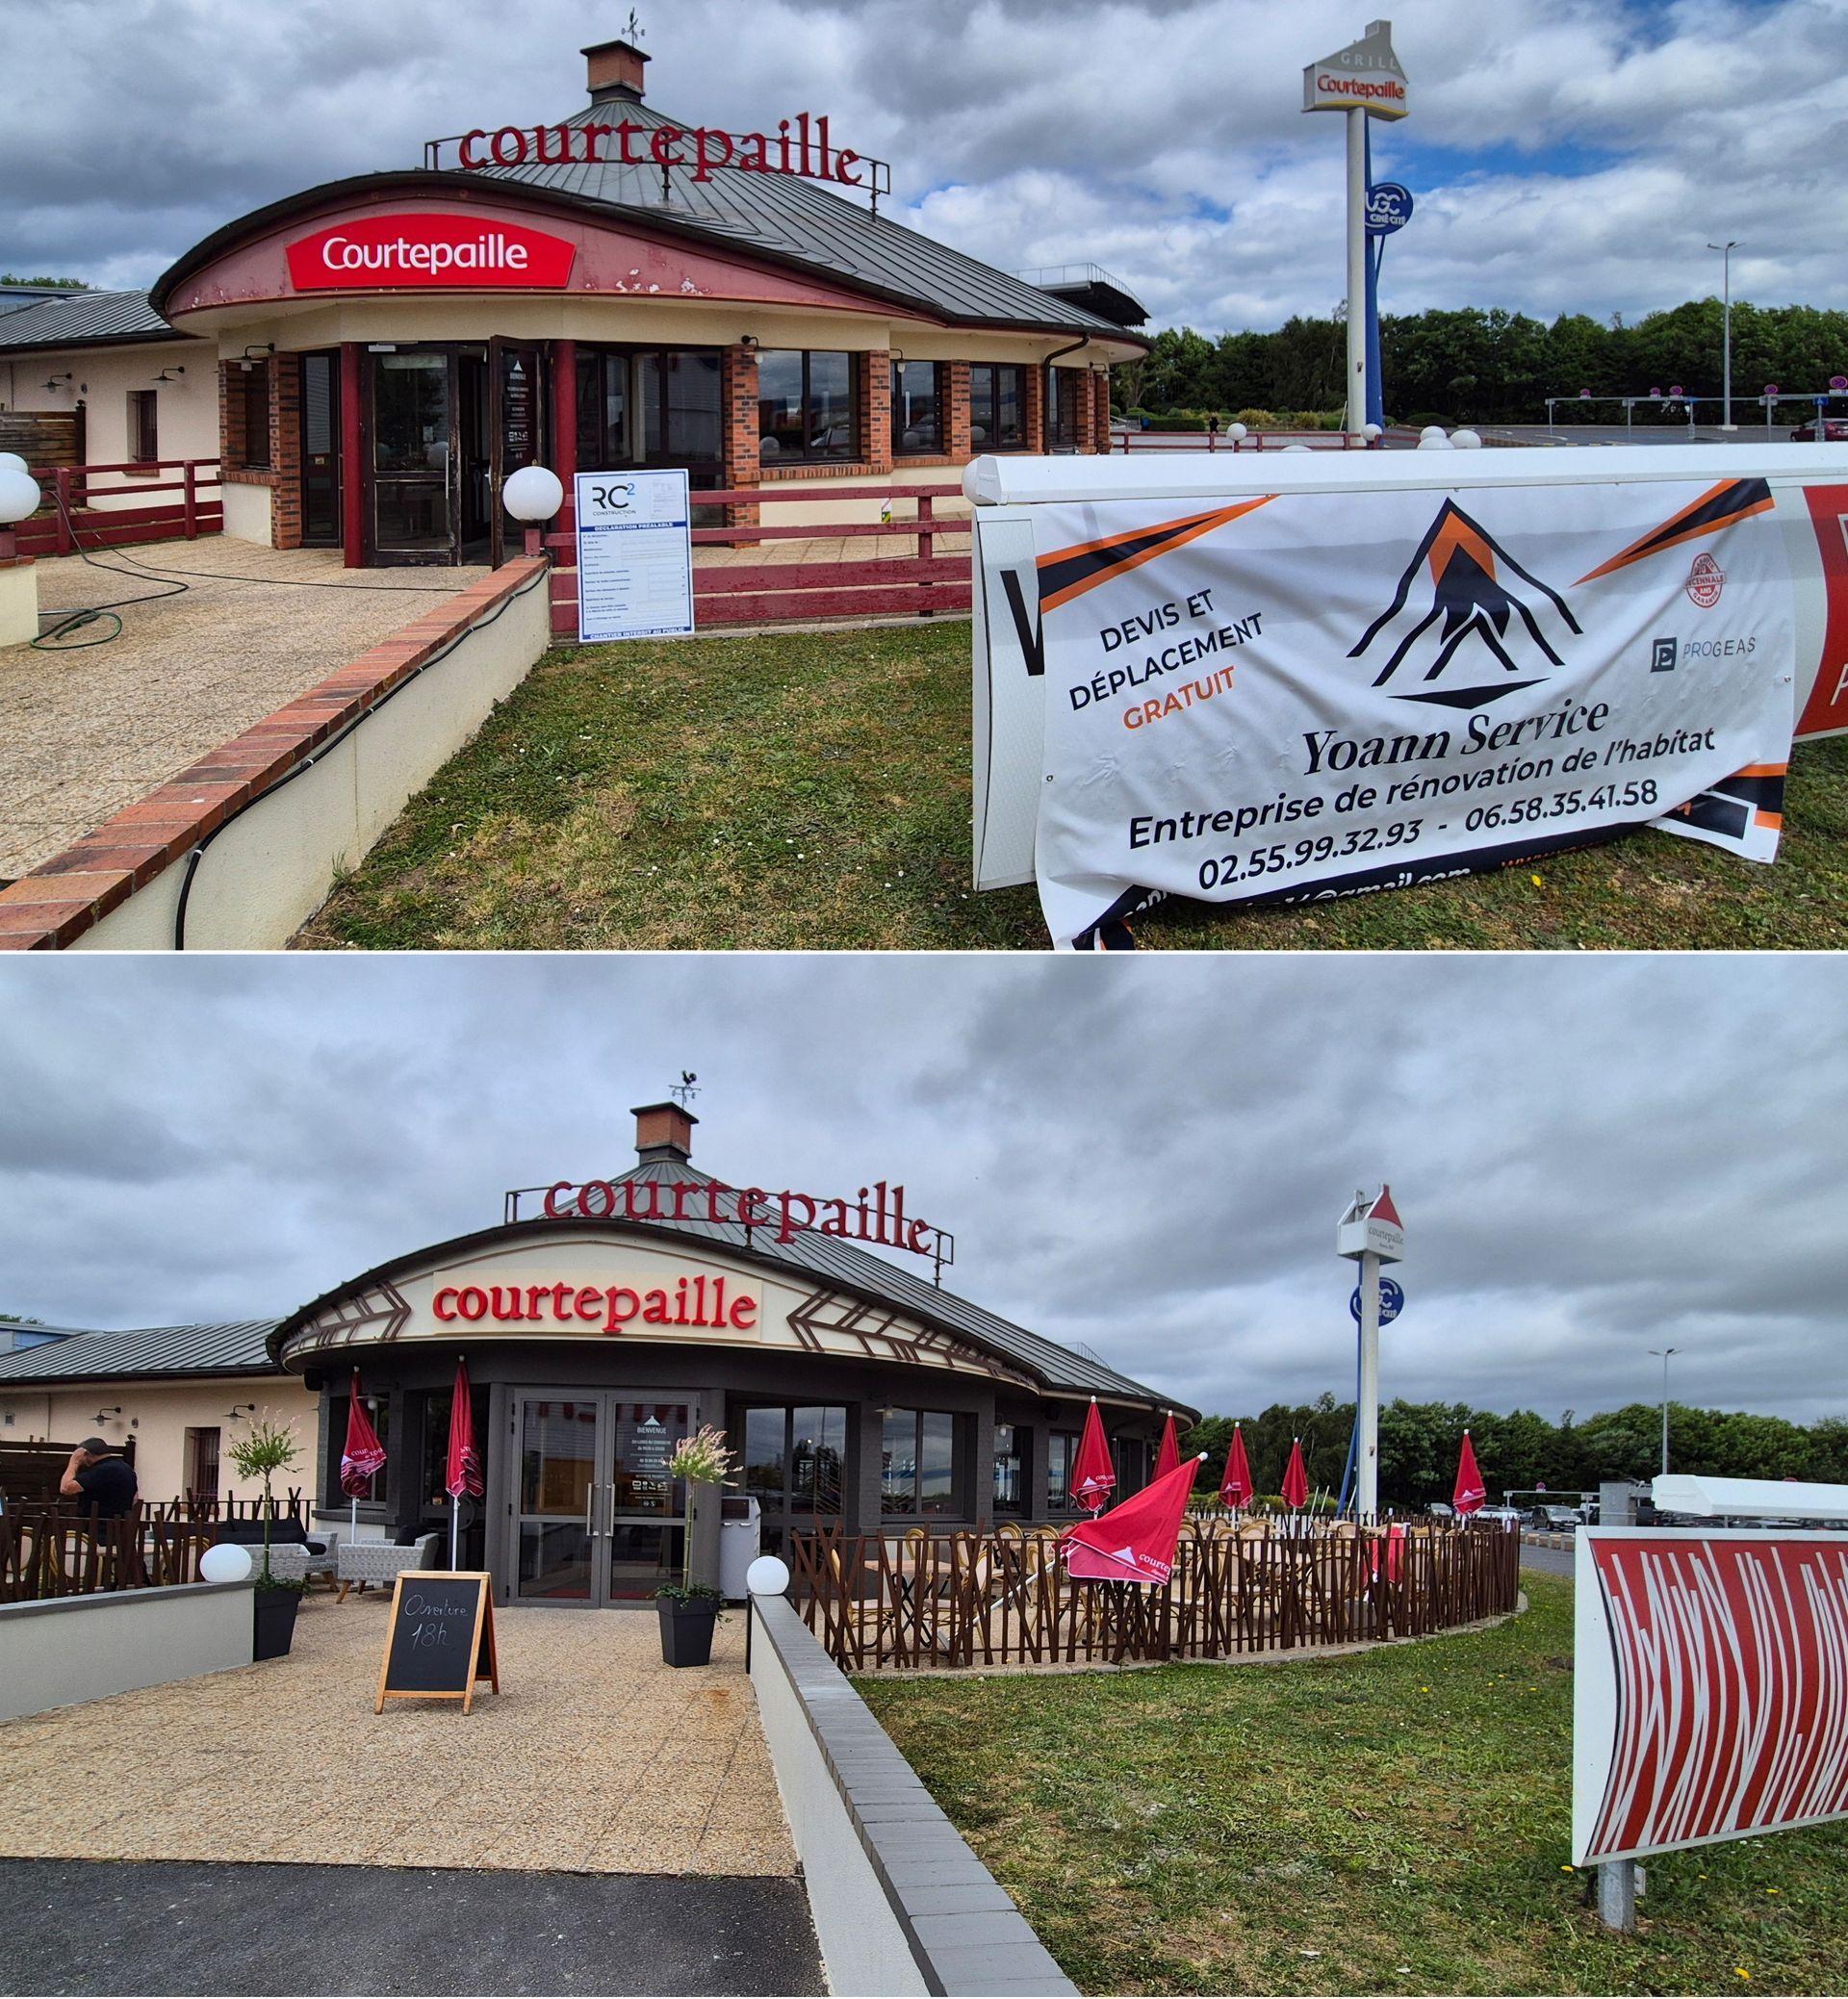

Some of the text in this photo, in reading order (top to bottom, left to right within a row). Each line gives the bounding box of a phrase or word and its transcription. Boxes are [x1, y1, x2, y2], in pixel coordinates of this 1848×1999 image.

[1317, 74, 1405, 99] Courtepaille
[1341, 52, 1398, 70] GRILL
[458, 112, 862, 186] courtepaille
[1365, 192, 1400, 216] UGC
[322, 234, 528, 275] Courtepaille
[1100, 588, 1215, 653] DEVIS ET
[1682, 636, 1757, 658] PROGEAS
[1068, 612, 1263, 711] DÉPLACEMENT
[1123, 665, 1236, 730] GRATUIT
[1302, 698, 1608, 776] Yoann Service
[1129, 792, 1324, 849] Entreprise
[1334, 783, 1377, 813] de
[1386, 756, 1553, 806] rénovation
[1562, 745, 1598, 773] de
[1198, 818, 1424, 890] 02.55.99.32.93
[1465, 779, 1658, 832] 06.58.35.41.58
[544, 1180, 932, 1254] courtepaille
[433, 1274, 757, 1334] courtepaille
[411, 1622, 450, 1651] 18h
